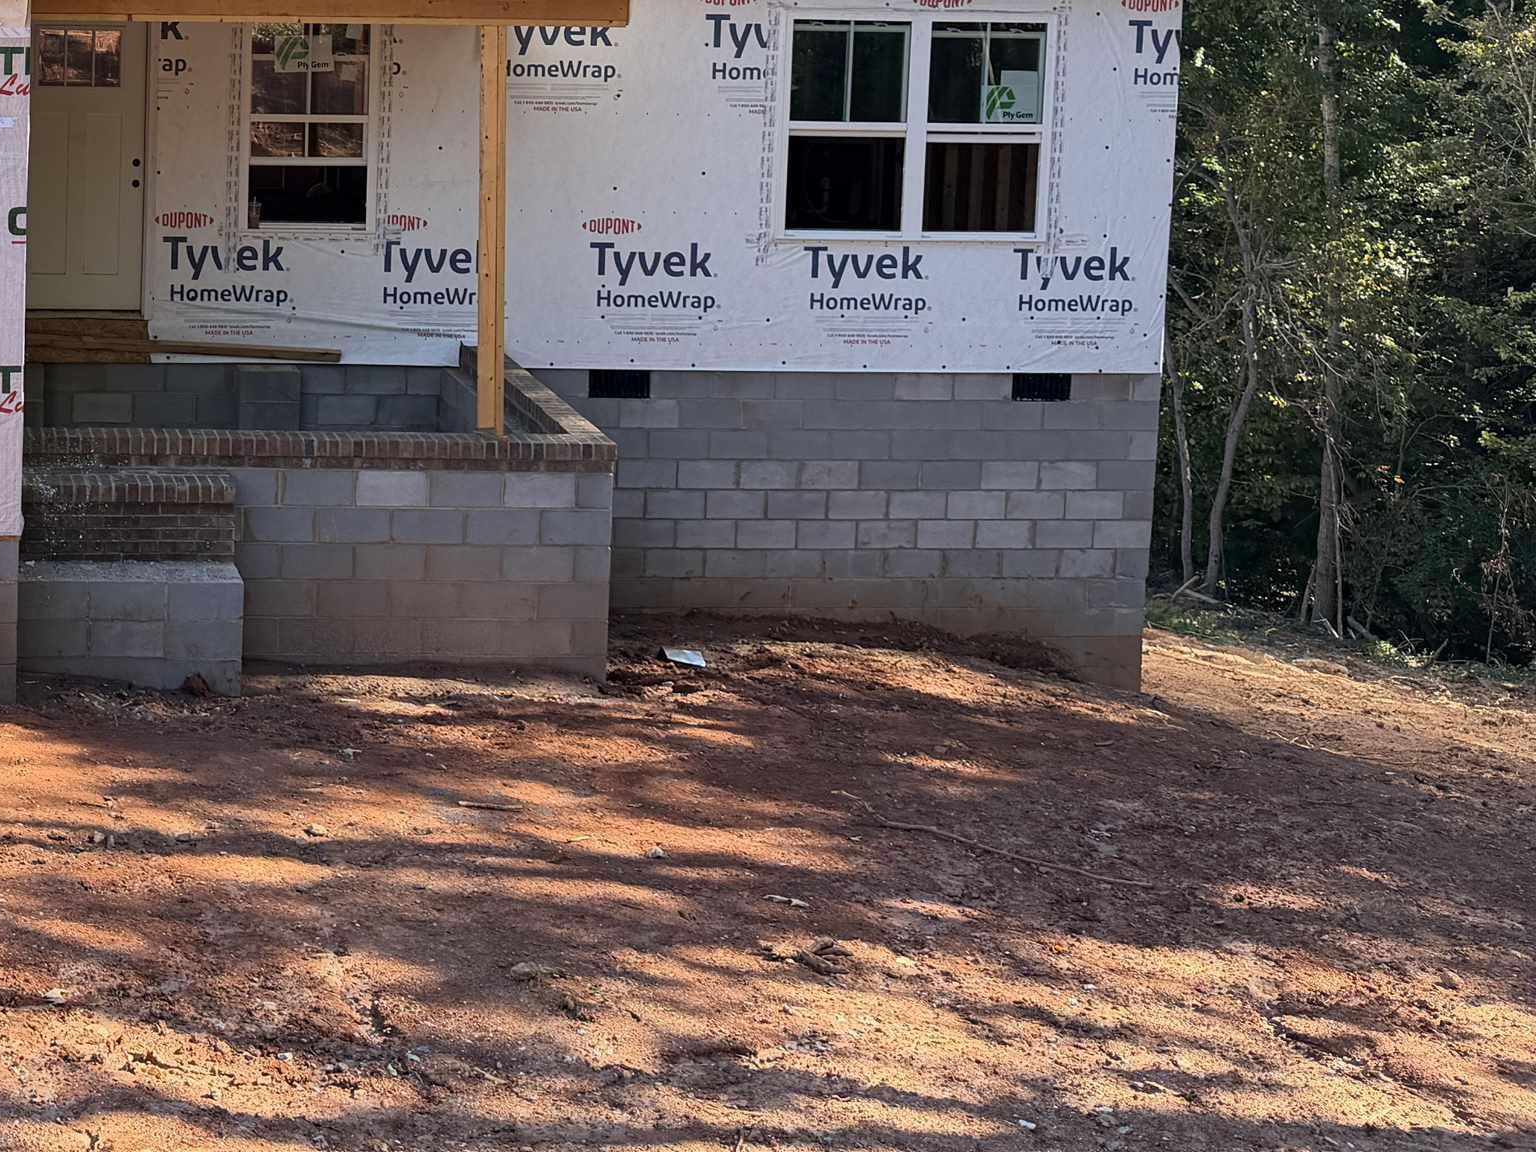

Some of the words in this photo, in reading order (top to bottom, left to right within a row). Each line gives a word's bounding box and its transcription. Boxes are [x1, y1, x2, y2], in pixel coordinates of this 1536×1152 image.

[1002, 111, 1015, 120] Ply
[1016, 111, 1034, 119] Gem
[161, 212, 209, 229] DUPONT
[589, 217, 636, 235] DUPONT
[590, 242, 713, 286] Tyvek
[803, 246, 924, 289] Tyvek
[1013, 247, 1131, 291] Tyvek
[169, 284, 289, 308] HomeWrap
[595, 289, 717, 313] HomeWrap
[809, 292, 928, 315] HomeWrap
[1018, 294, 1134, 316] HomeWrap
